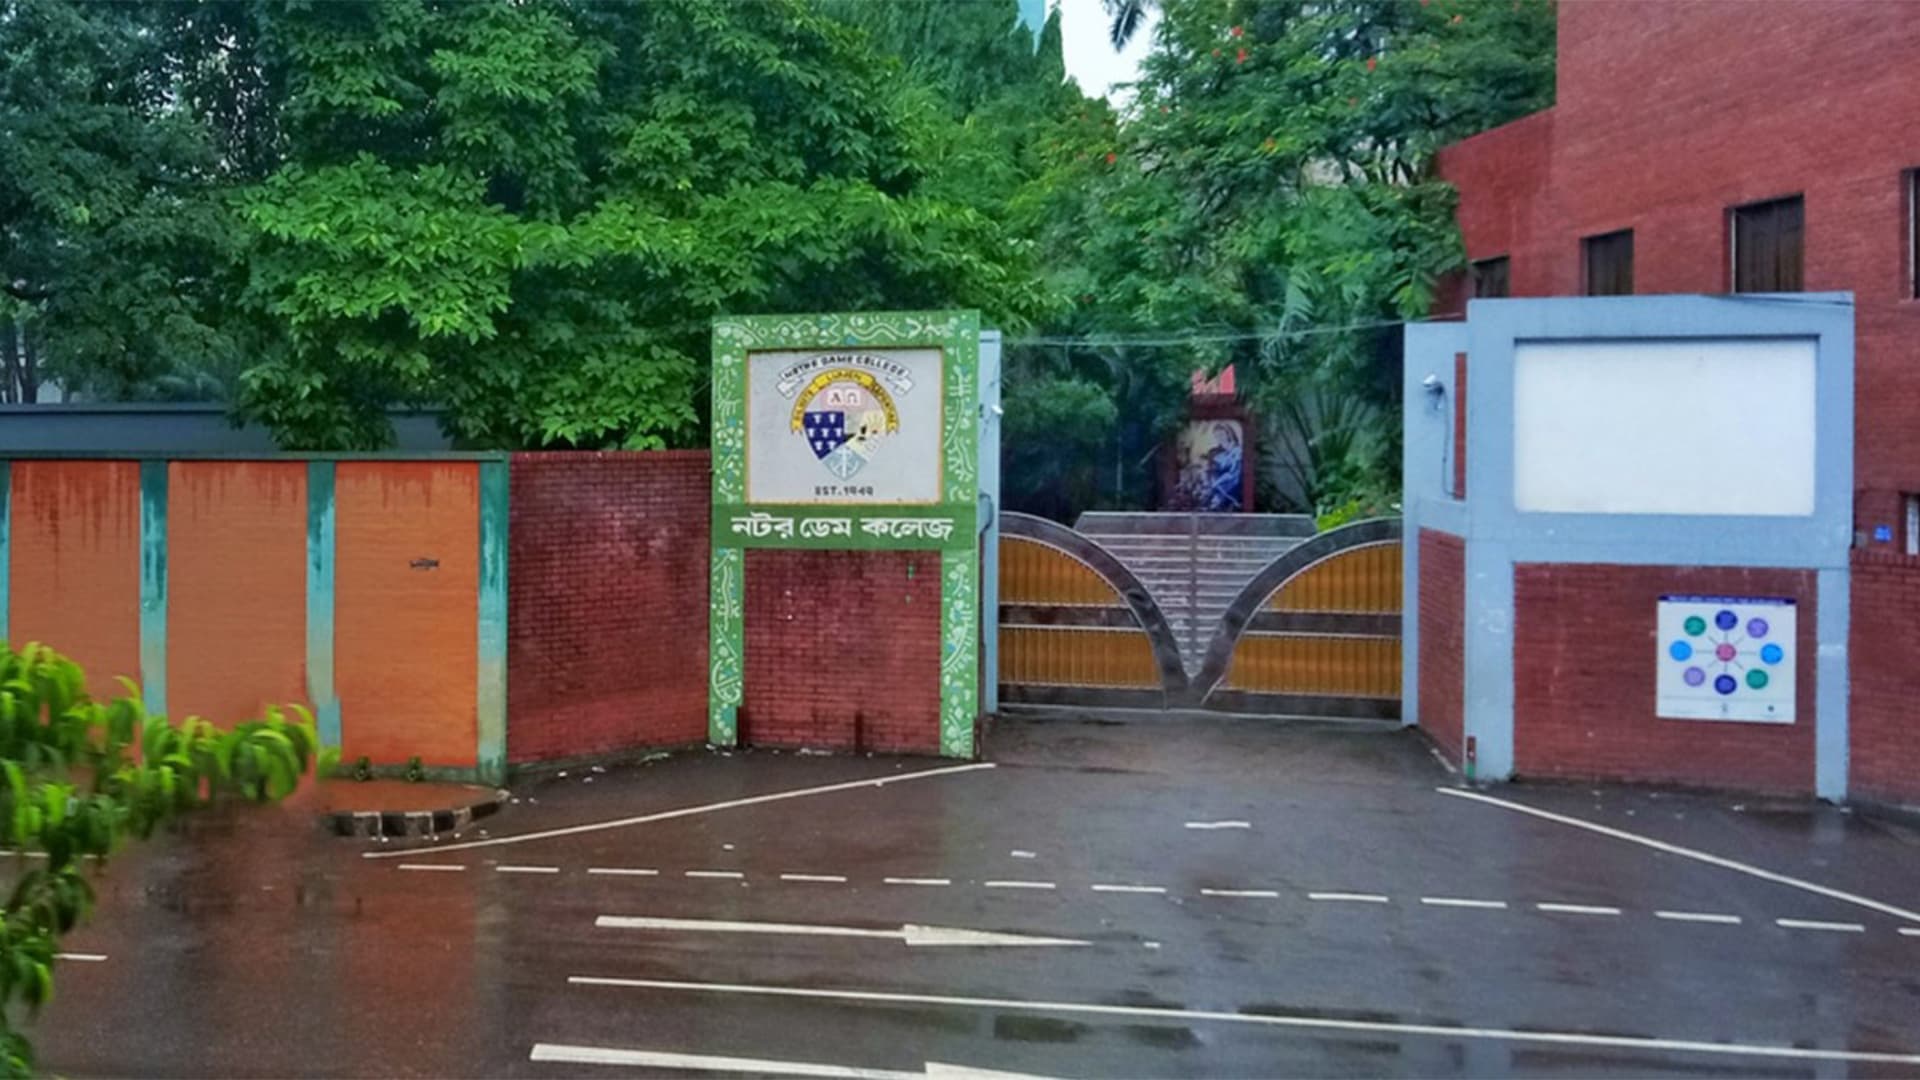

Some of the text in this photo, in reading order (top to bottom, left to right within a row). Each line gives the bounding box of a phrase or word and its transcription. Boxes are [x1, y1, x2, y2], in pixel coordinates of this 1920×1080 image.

[784, 354, 906, 378] NOTRE DAME COLLEGE
[731, 511, 955, 541] নটর ডেম কলেজ
